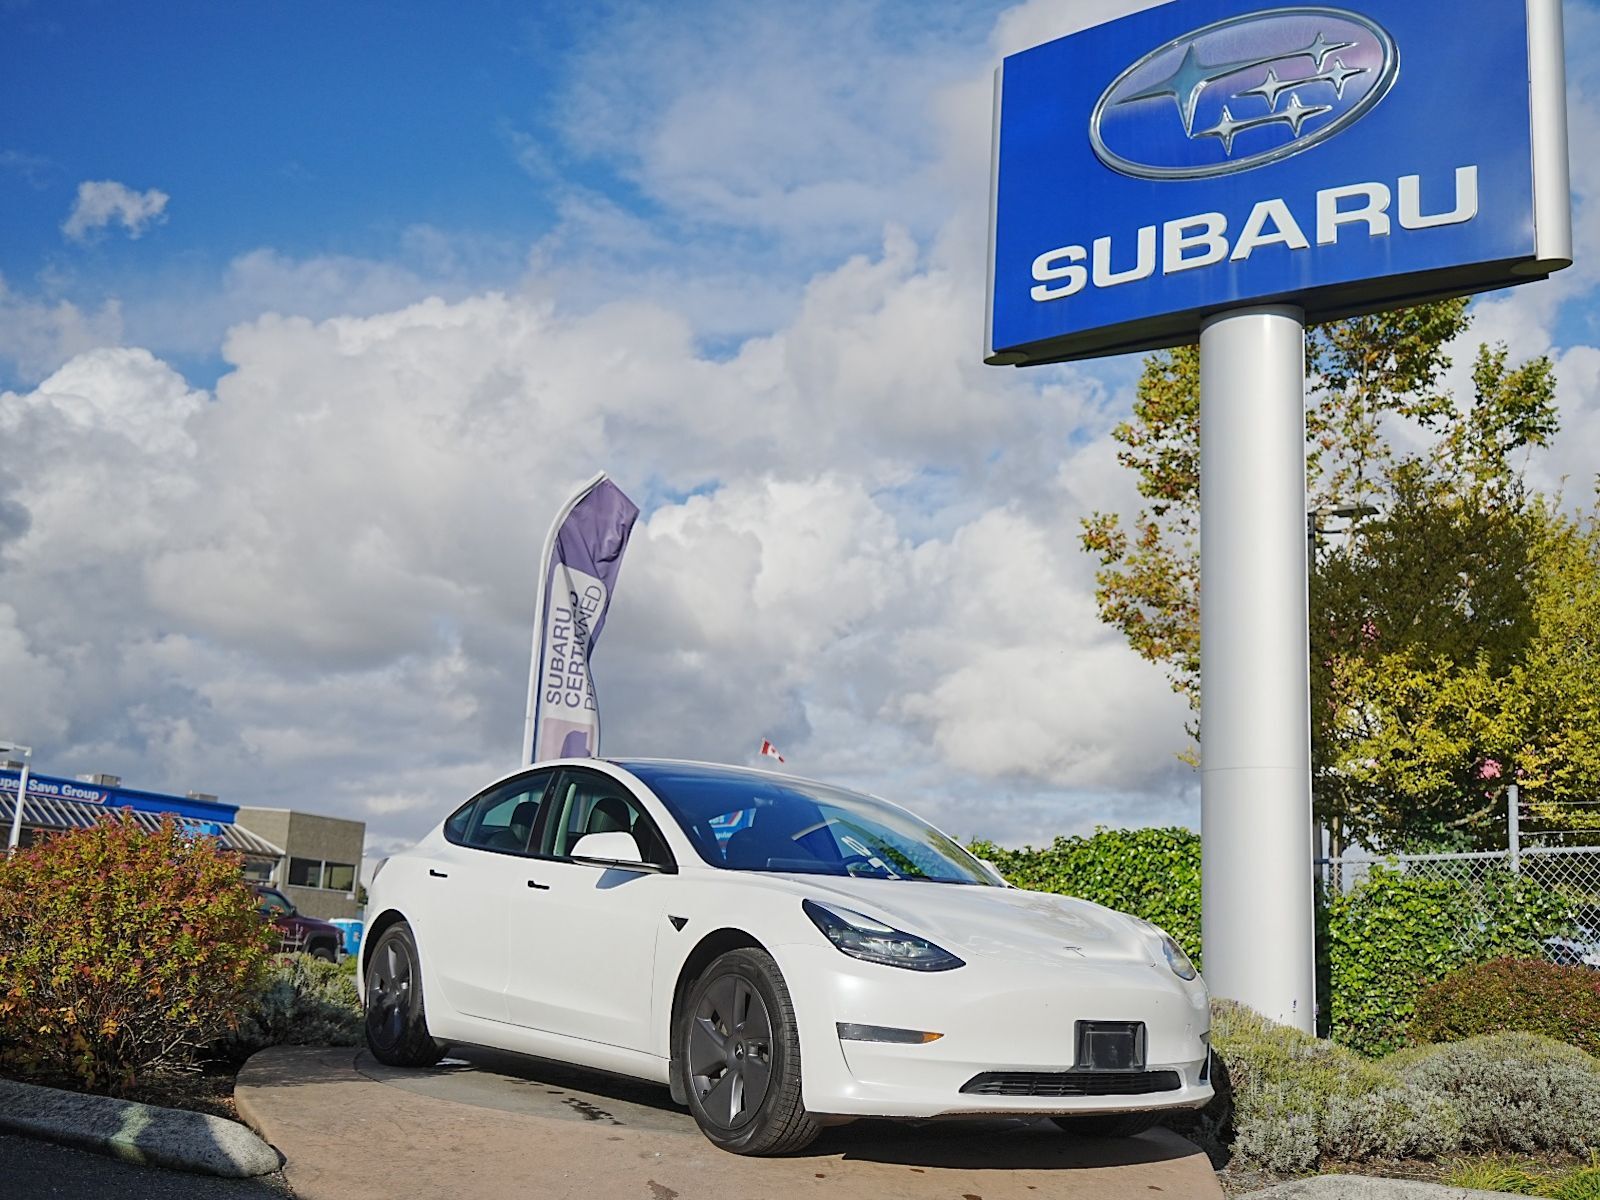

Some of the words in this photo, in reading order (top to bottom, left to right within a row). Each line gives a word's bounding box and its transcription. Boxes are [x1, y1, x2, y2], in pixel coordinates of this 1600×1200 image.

[1029, 165, 1479, 302] SUBARU
[546, 607, 572, 705] SUBARU
[29, 779, 58, 794] Save
[61, 784, 99, 801] Group
